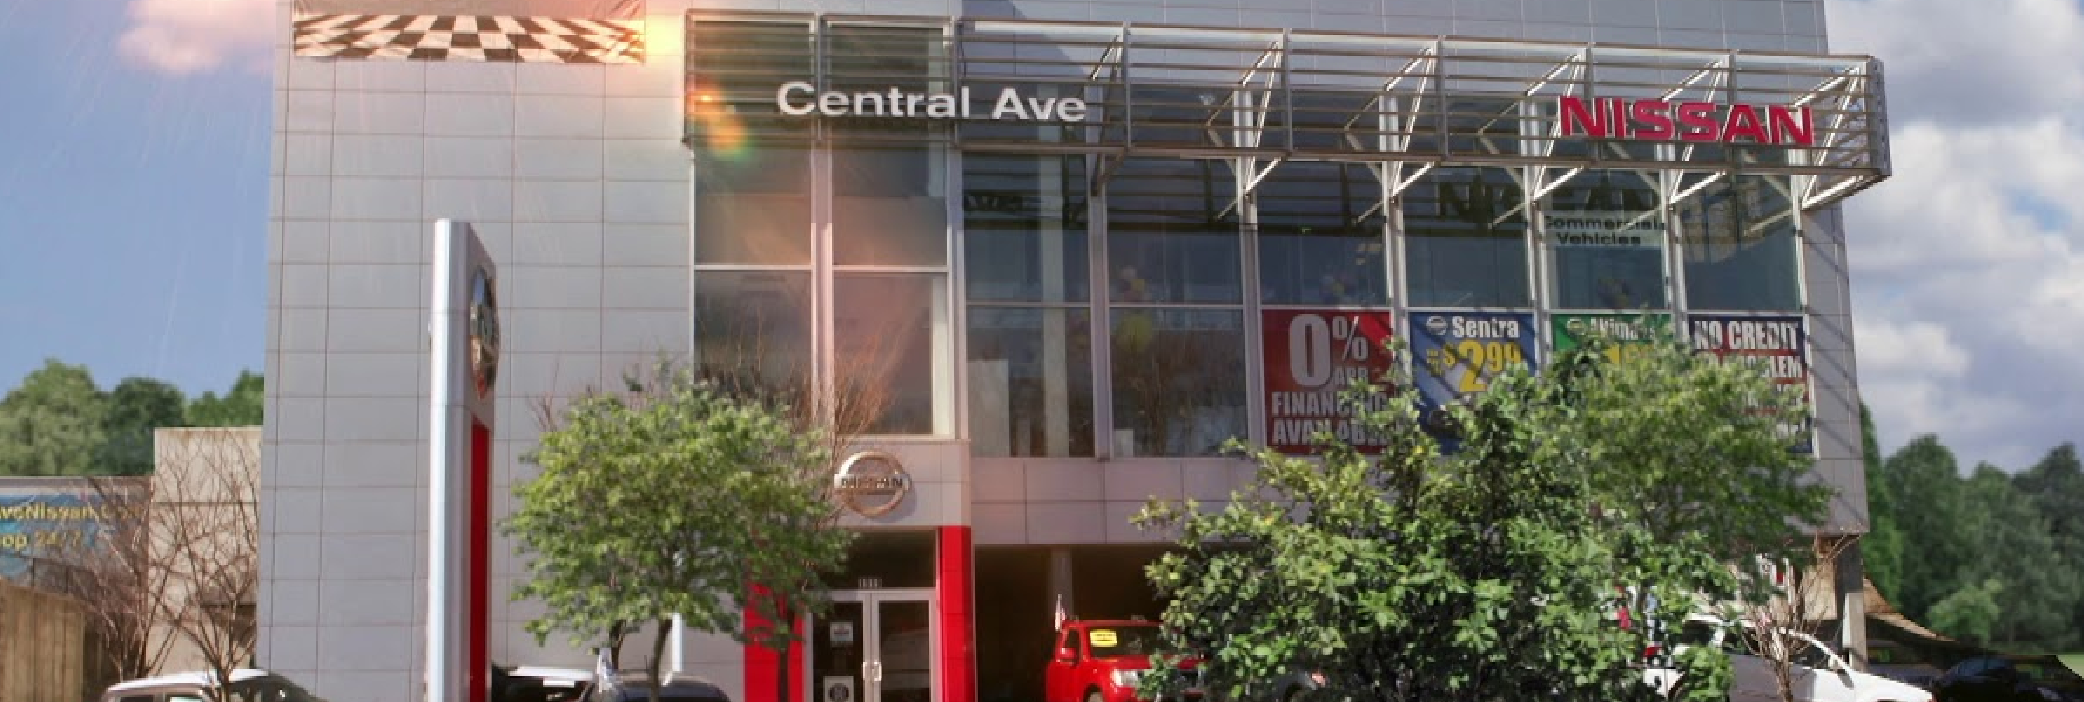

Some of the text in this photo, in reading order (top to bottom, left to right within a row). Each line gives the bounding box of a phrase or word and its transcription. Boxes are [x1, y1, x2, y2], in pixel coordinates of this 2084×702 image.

[777, 81, 1087, 121] Central Ave
[1557, 95, 1815, 145] NISSAN
[1556, 231, 1642, 245] Vehicles
[1452, 315, 1520, 338] Sentra
[1694, 320, 1799, 351] NO CREDIT
